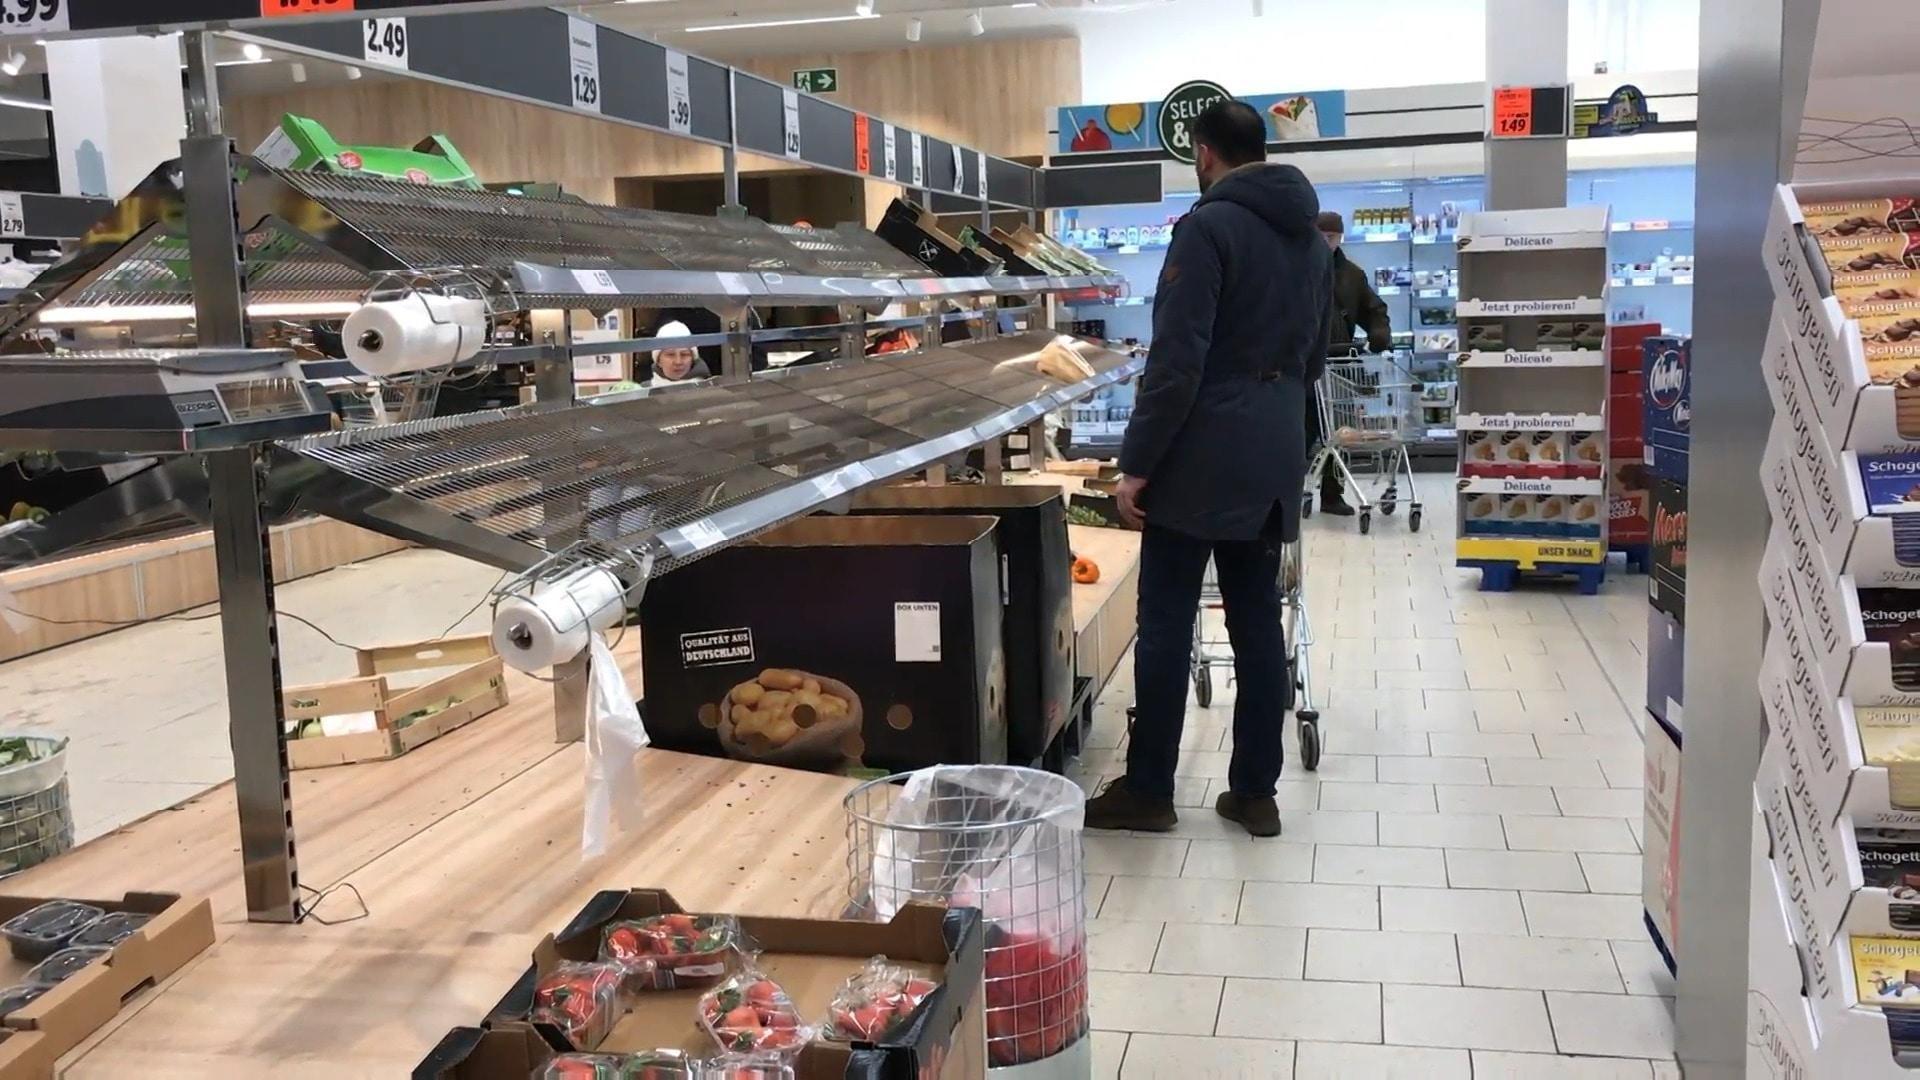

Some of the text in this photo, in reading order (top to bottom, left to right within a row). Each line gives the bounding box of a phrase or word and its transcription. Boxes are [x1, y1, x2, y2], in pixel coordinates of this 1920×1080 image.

[368, 18, 405, 58] 2.49
[574, 73, 597, 104] 1.29
[1501, 119, 1526, 132] 1.49
[1504, 237, 1554, 247] Delicate
[1480, 301, 1576, 314] Jetzt probieren!
[1504, 353, 1553, 364] Delicate
[1480, 417, 1575, 429] Jetzt probieren!
[1504, 482, 1552, 492] Delicate
[686, 645, 751, 661] DEUTSCHLAND
